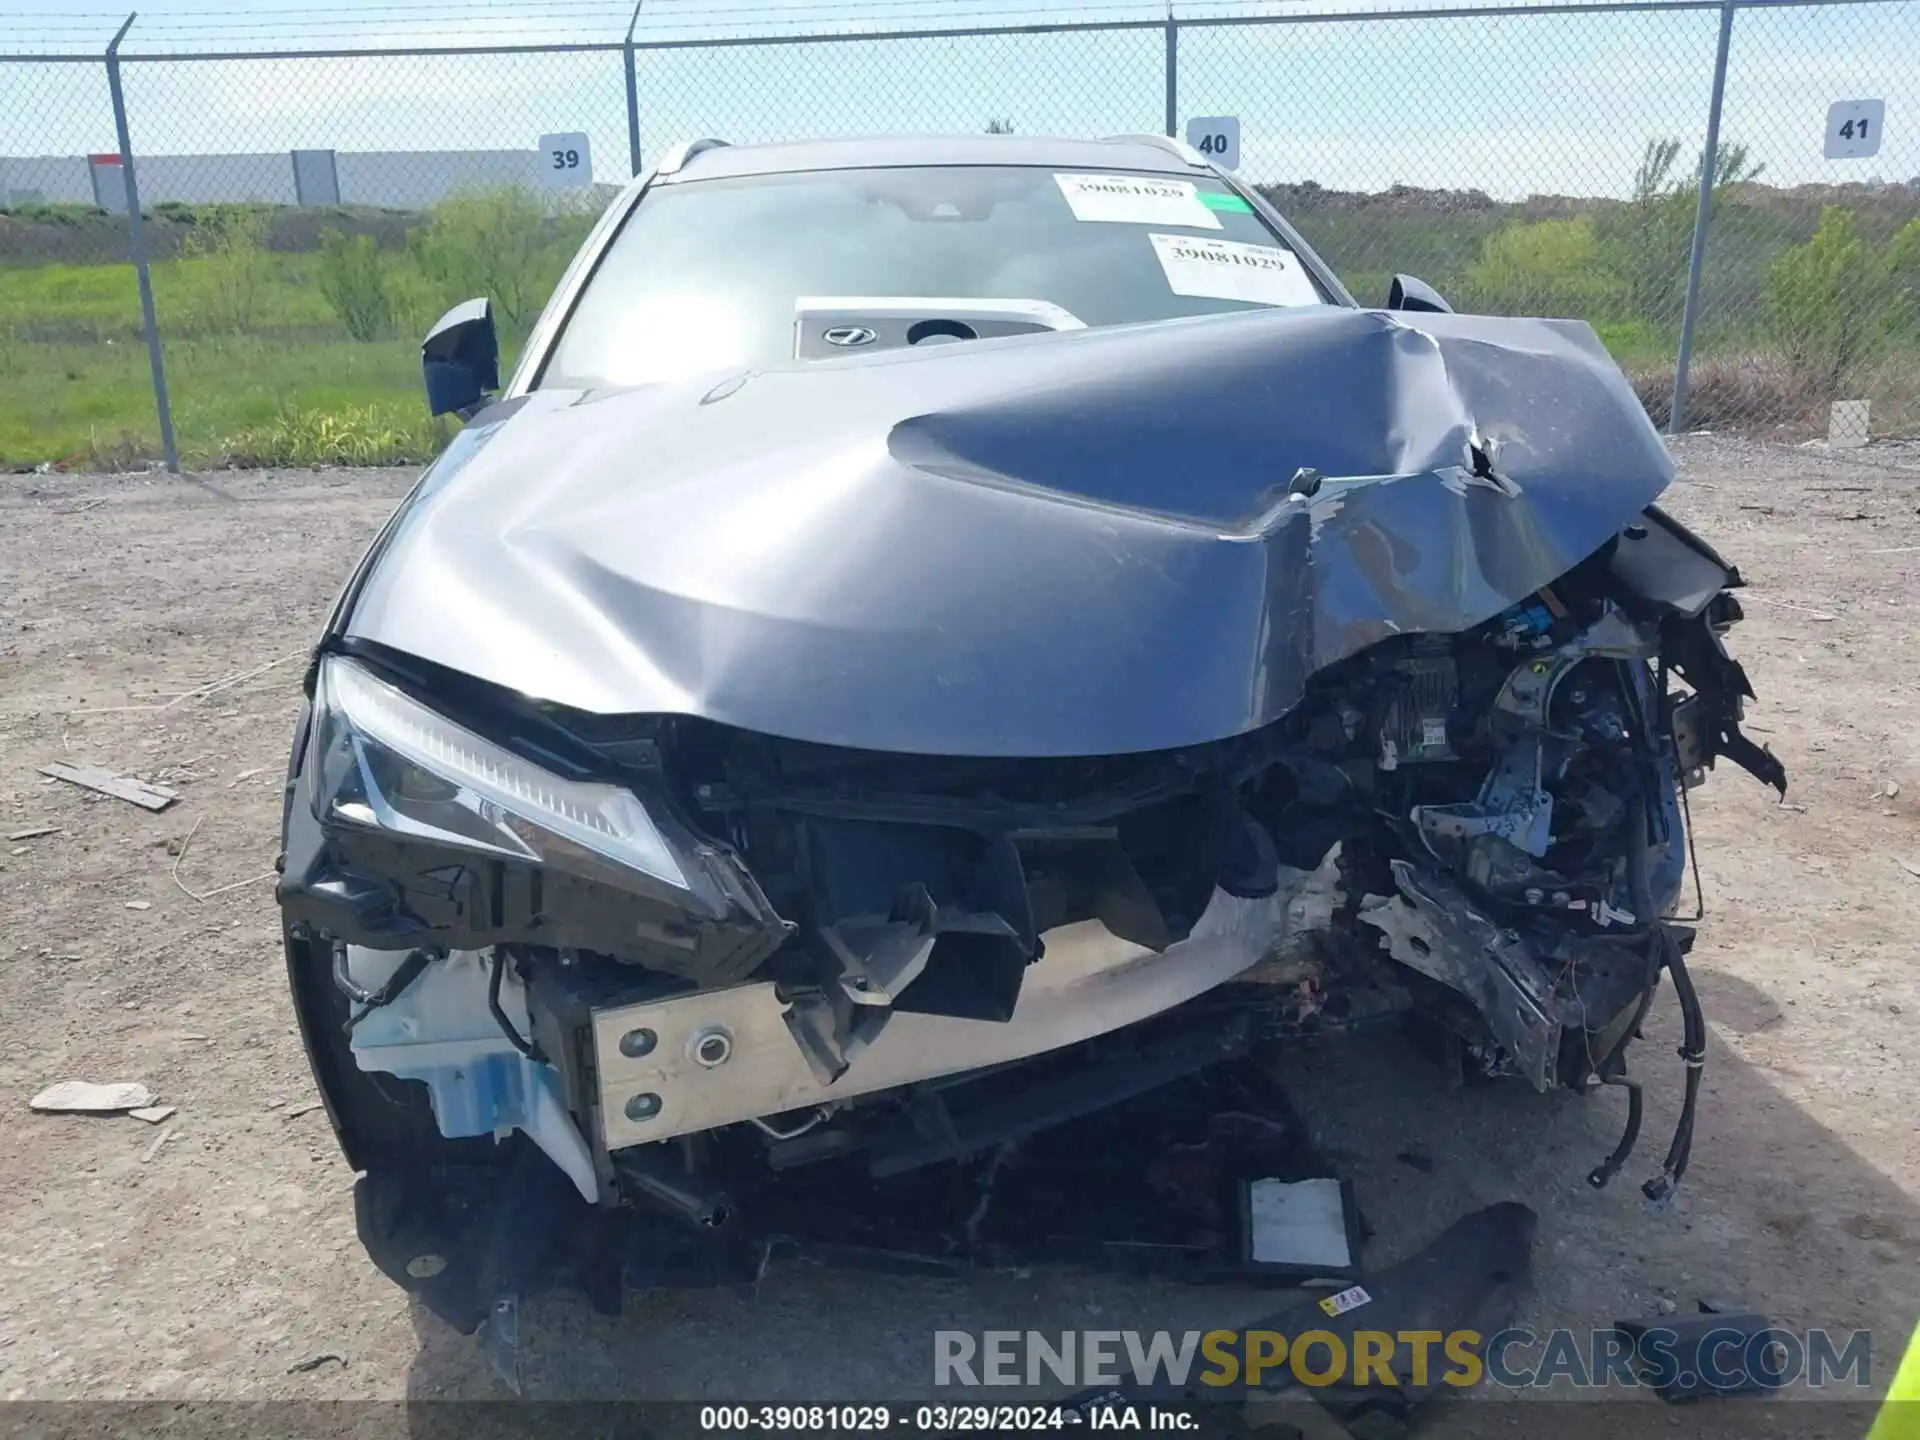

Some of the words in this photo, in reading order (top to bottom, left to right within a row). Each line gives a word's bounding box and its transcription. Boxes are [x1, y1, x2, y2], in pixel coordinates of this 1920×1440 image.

[1839, 118, 1868, 140] 41
[1199, 134, 1227, 154] 40
[552, 150, 579, 170] 39
[1077, 182, 1185, 198] 39081029
[1171, 246, 1286, 271] 39081029
